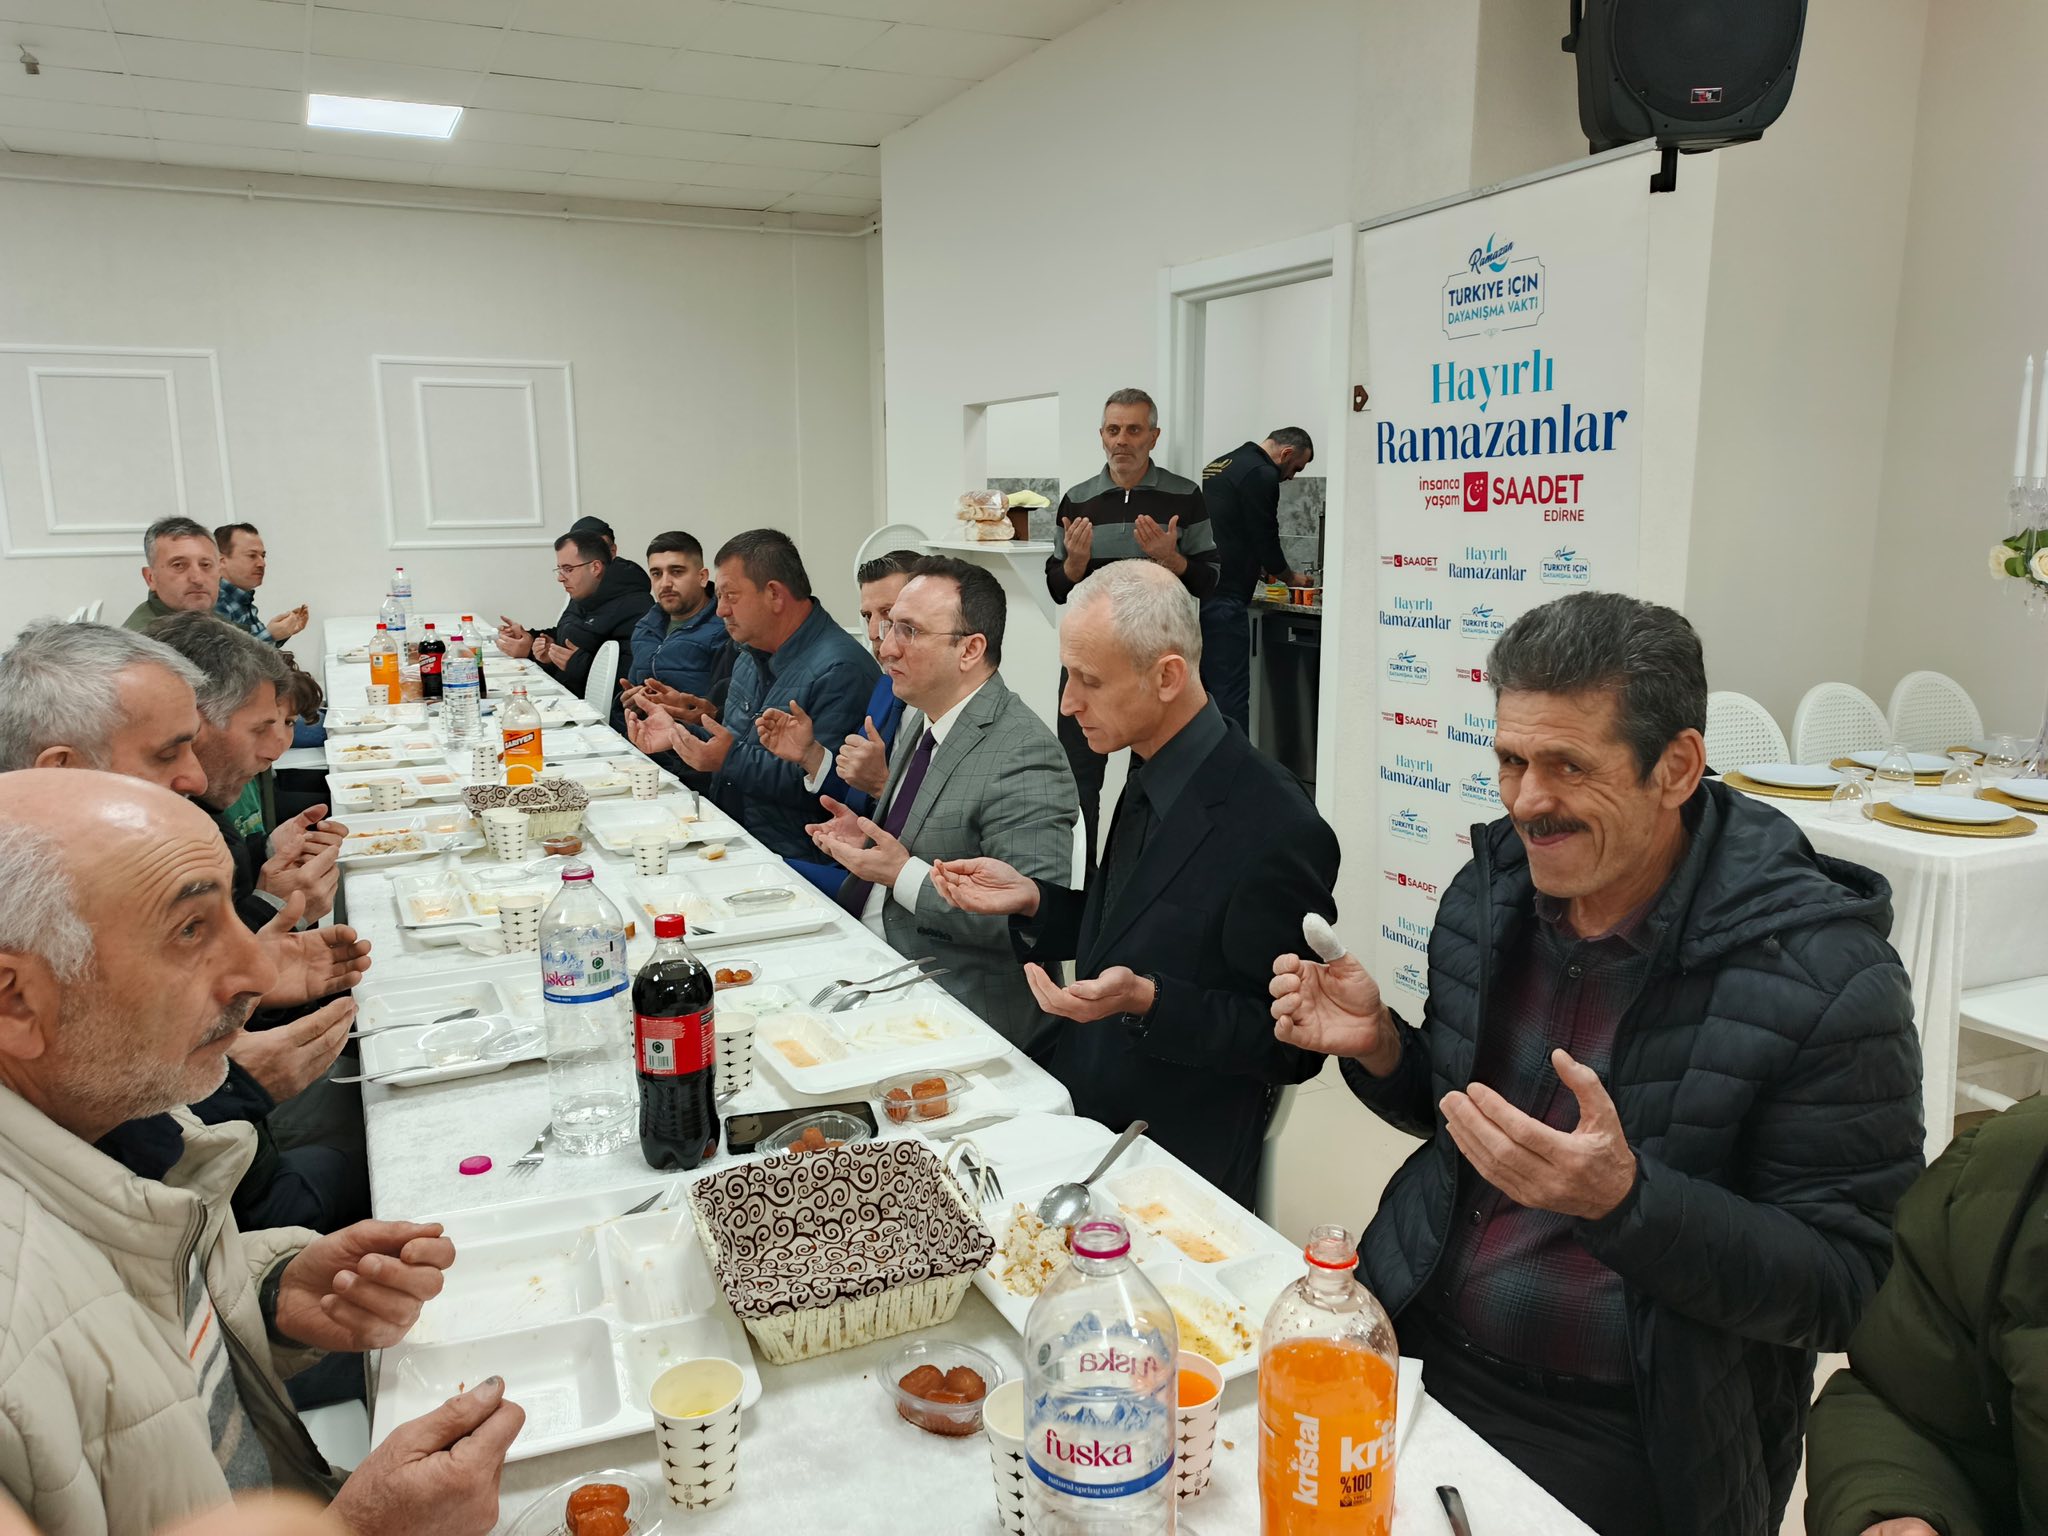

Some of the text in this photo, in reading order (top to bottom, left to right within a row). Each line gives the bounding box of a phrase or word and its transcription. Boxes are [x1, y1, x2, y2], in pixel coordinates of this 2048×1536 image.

[1469, 241, 1514, 274] Ramazan
[1448, 304, 1504, 324] DAYANIŞMA
[1431, 349, 1554, 413] Hayırlı
[1376, 403, 1628, 464] Ramazanlar
[1419, 476, 1460, 490] insanca
[1492, 474, 1584, 505] SAADET
[1425, 494, 1460, 510] yaşam
[1544, 507, 1585, 522] EDİRNE
[1403, 557, 1438, 566] SAADET
[1465, 547, 1507, 564] Hayırlı
[1448, 563, 1527, 581] Ramazanlar
[1394, 596, 1432, 613] Hayırlı
[1380, 611, 1451, 630] Ramazanlar
[1405, 716, 1438, 728] SAADET
[1464, 713, 1497, 731] Hayır
[1447, 725, 1495, 748] Ramaza
[1396, 754, 1433, 773] Hayırlı
[1380, 765, 1451, 793] Ramazanlar
[1408, 878, 1438, 895] SAADET
[1045, 1429, 1132, 1467] fuska
[1291, 1411, 1319, 1505] kristal
[1048, 1475, 1125, 1495] natural spring water
[1340, 1472, 1371, 1494] %100
